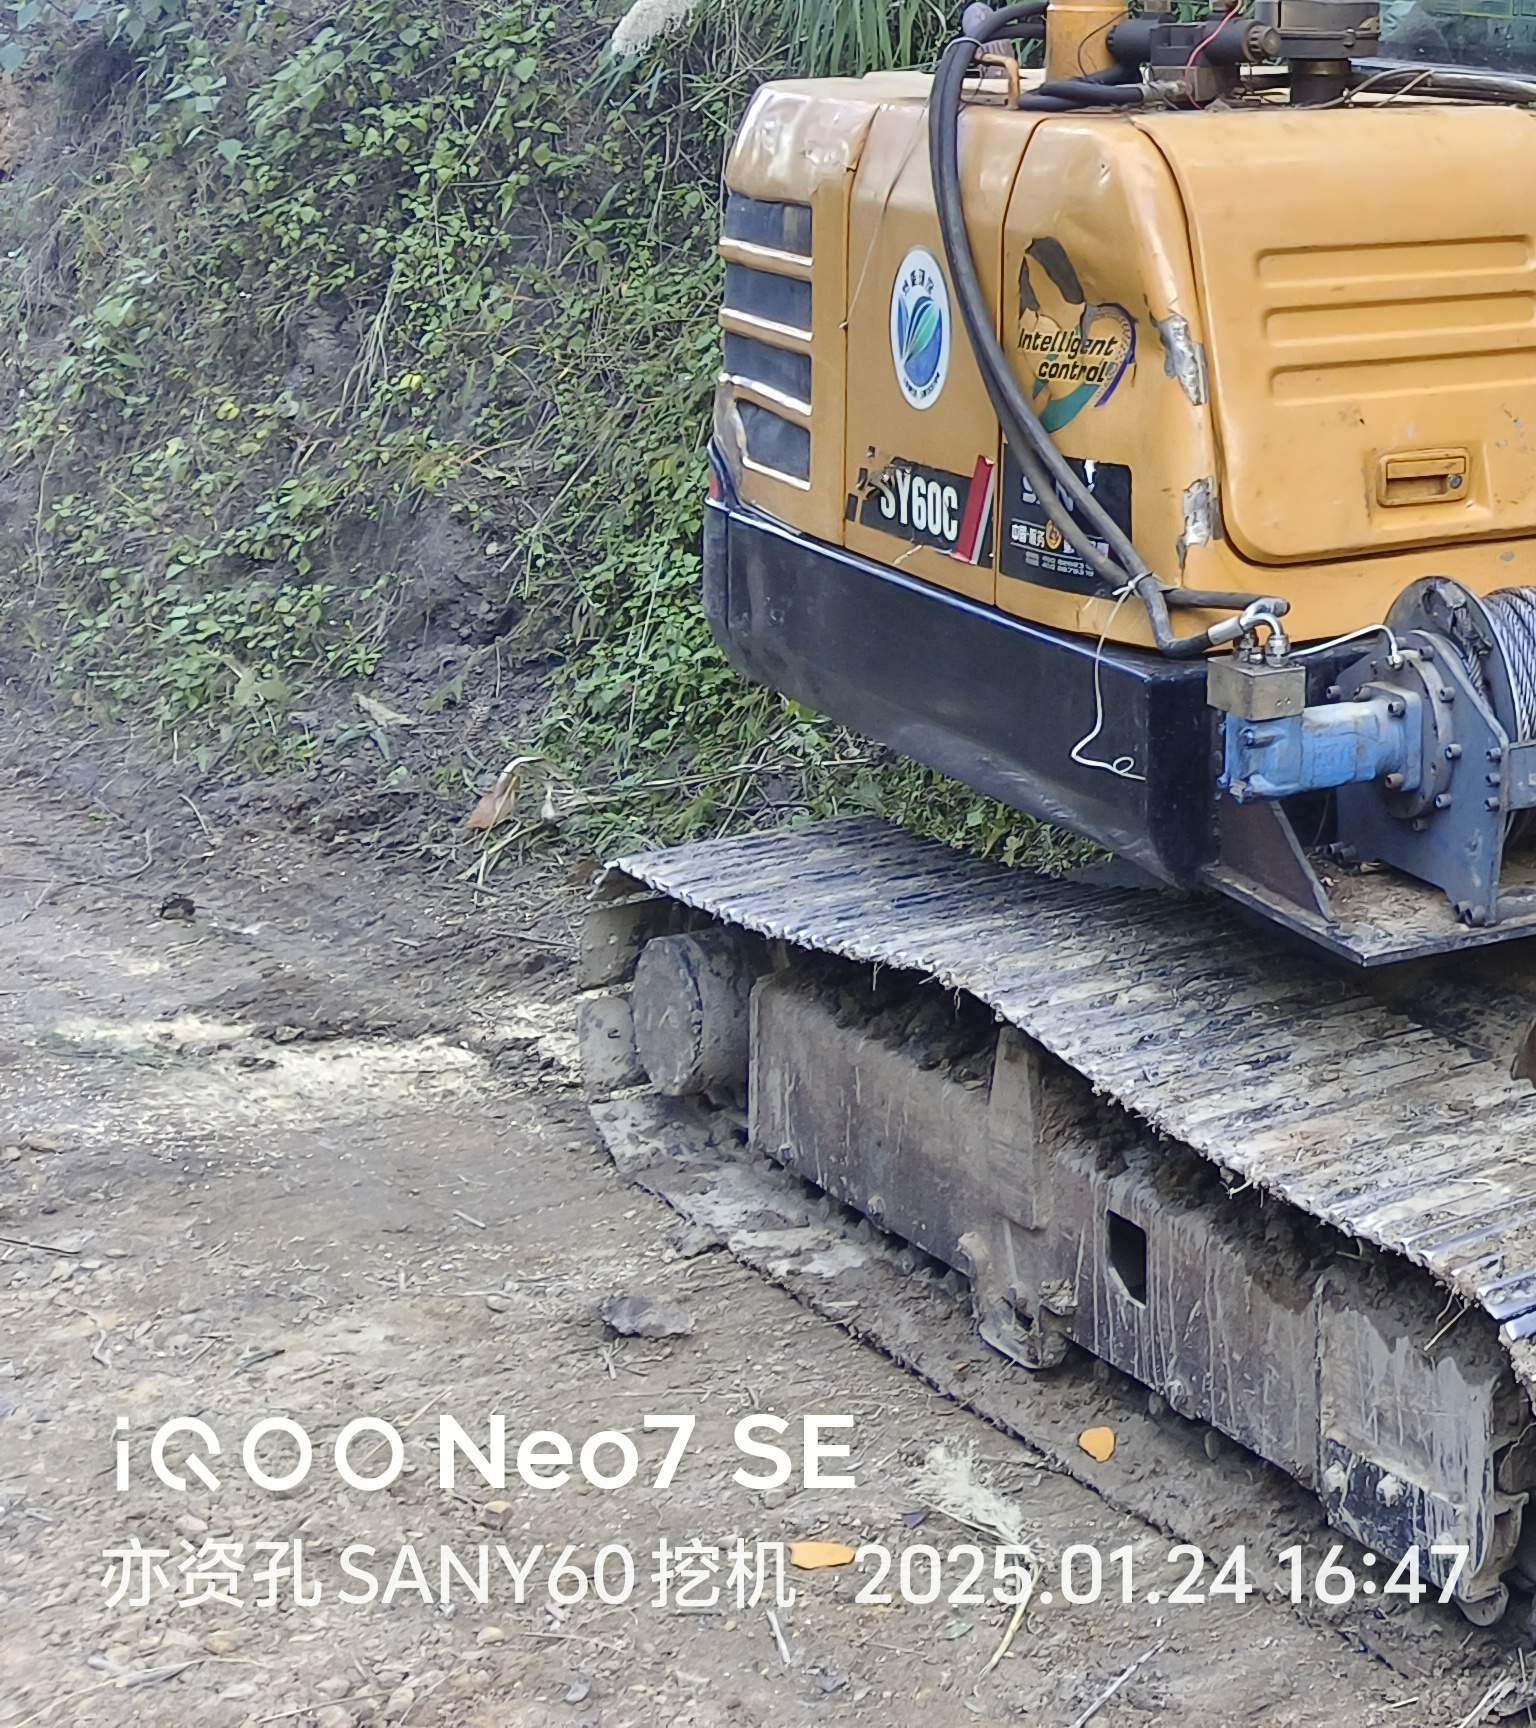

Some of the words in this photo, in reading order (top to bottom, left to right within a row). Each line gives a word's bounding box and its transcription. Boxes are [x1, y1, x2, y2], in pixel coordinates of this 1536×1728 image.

[1018, 328, 1118, 359] Intelligent
[1039, 361, 1107, 382] control
[880, 468, 958, 541] SY60C
